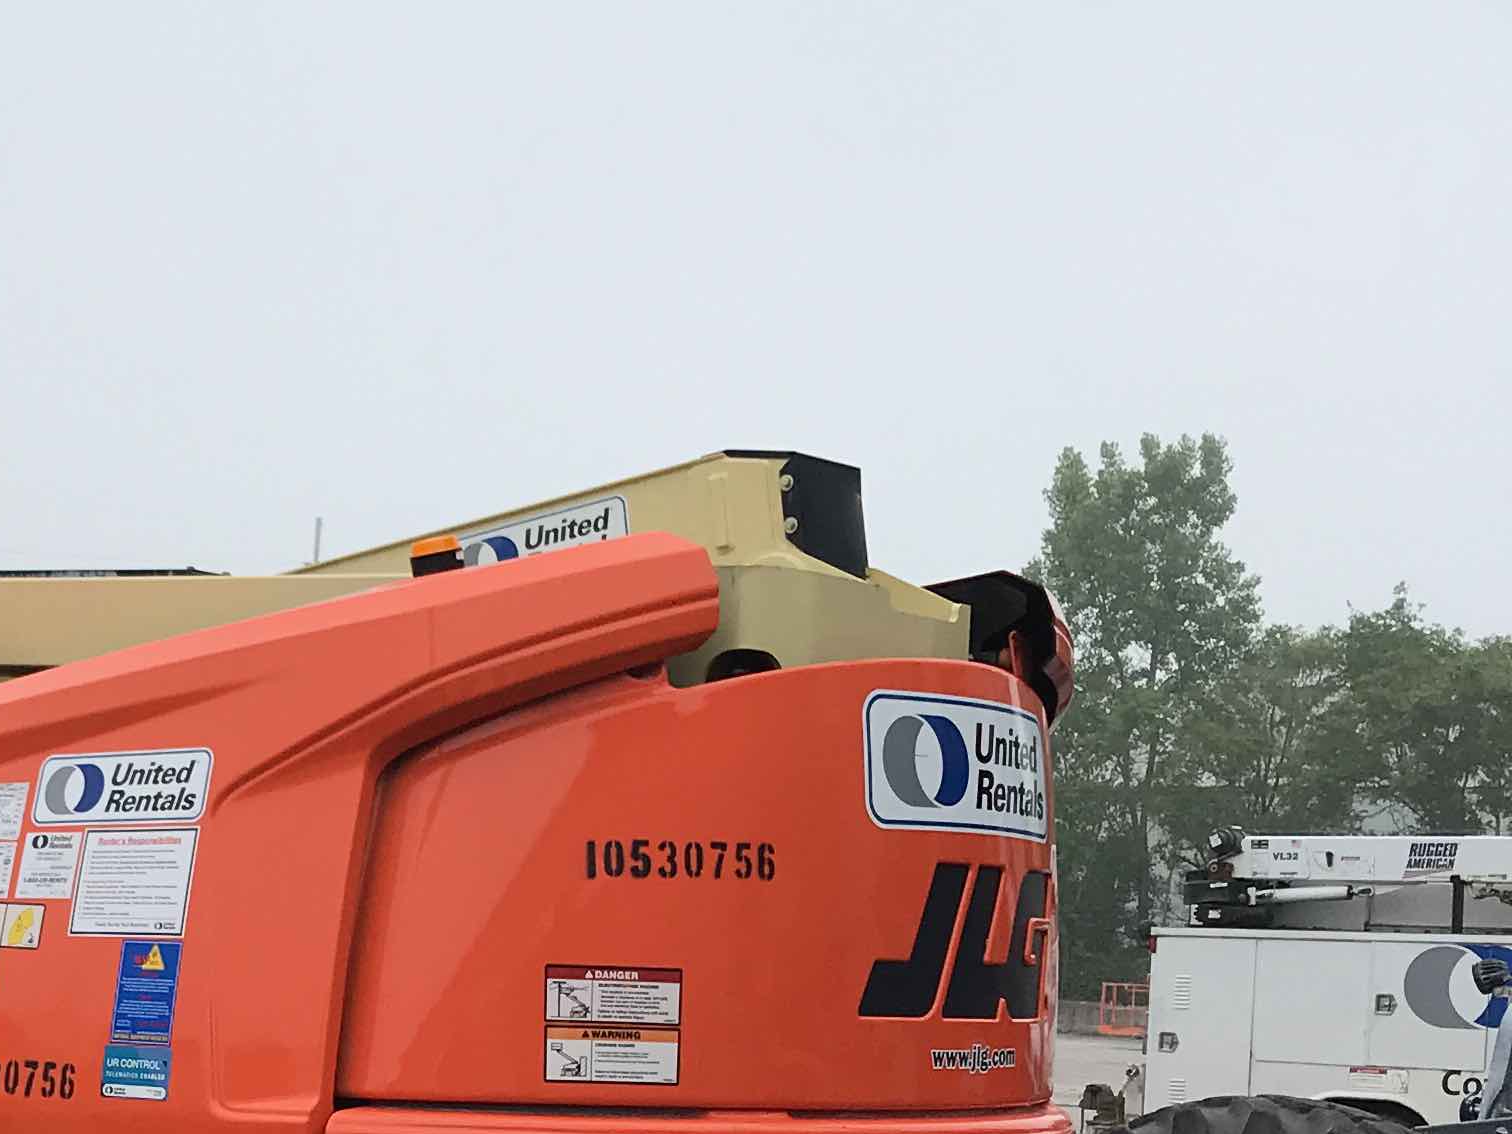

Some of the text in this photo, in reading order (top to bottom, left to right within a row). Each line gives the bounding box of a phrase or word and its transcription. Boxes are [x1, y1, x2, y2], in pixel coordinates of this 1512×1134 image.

[525, 507, 610, 550] United
[975, 722, 1038, 773] United
[111, 759, 196, 786] United
[104, 787, 197, 813] Rentals
[975, 769, 1044, 820] Rentals
[586, 840, 775, 880] 10530756
[1409, 843, 1458, 857] RUGGED
[1406, 858, 1455, 869] AMERICAN
[858, 862, 1052, 1018] JLG
[595, 970, 638, 980] DANGER
[592, 1031, 641, 1039] WARNING
[120, 1058, 160, 1070] CONTROL
[932, 1046, 1016, 1071] www.jlg.com
